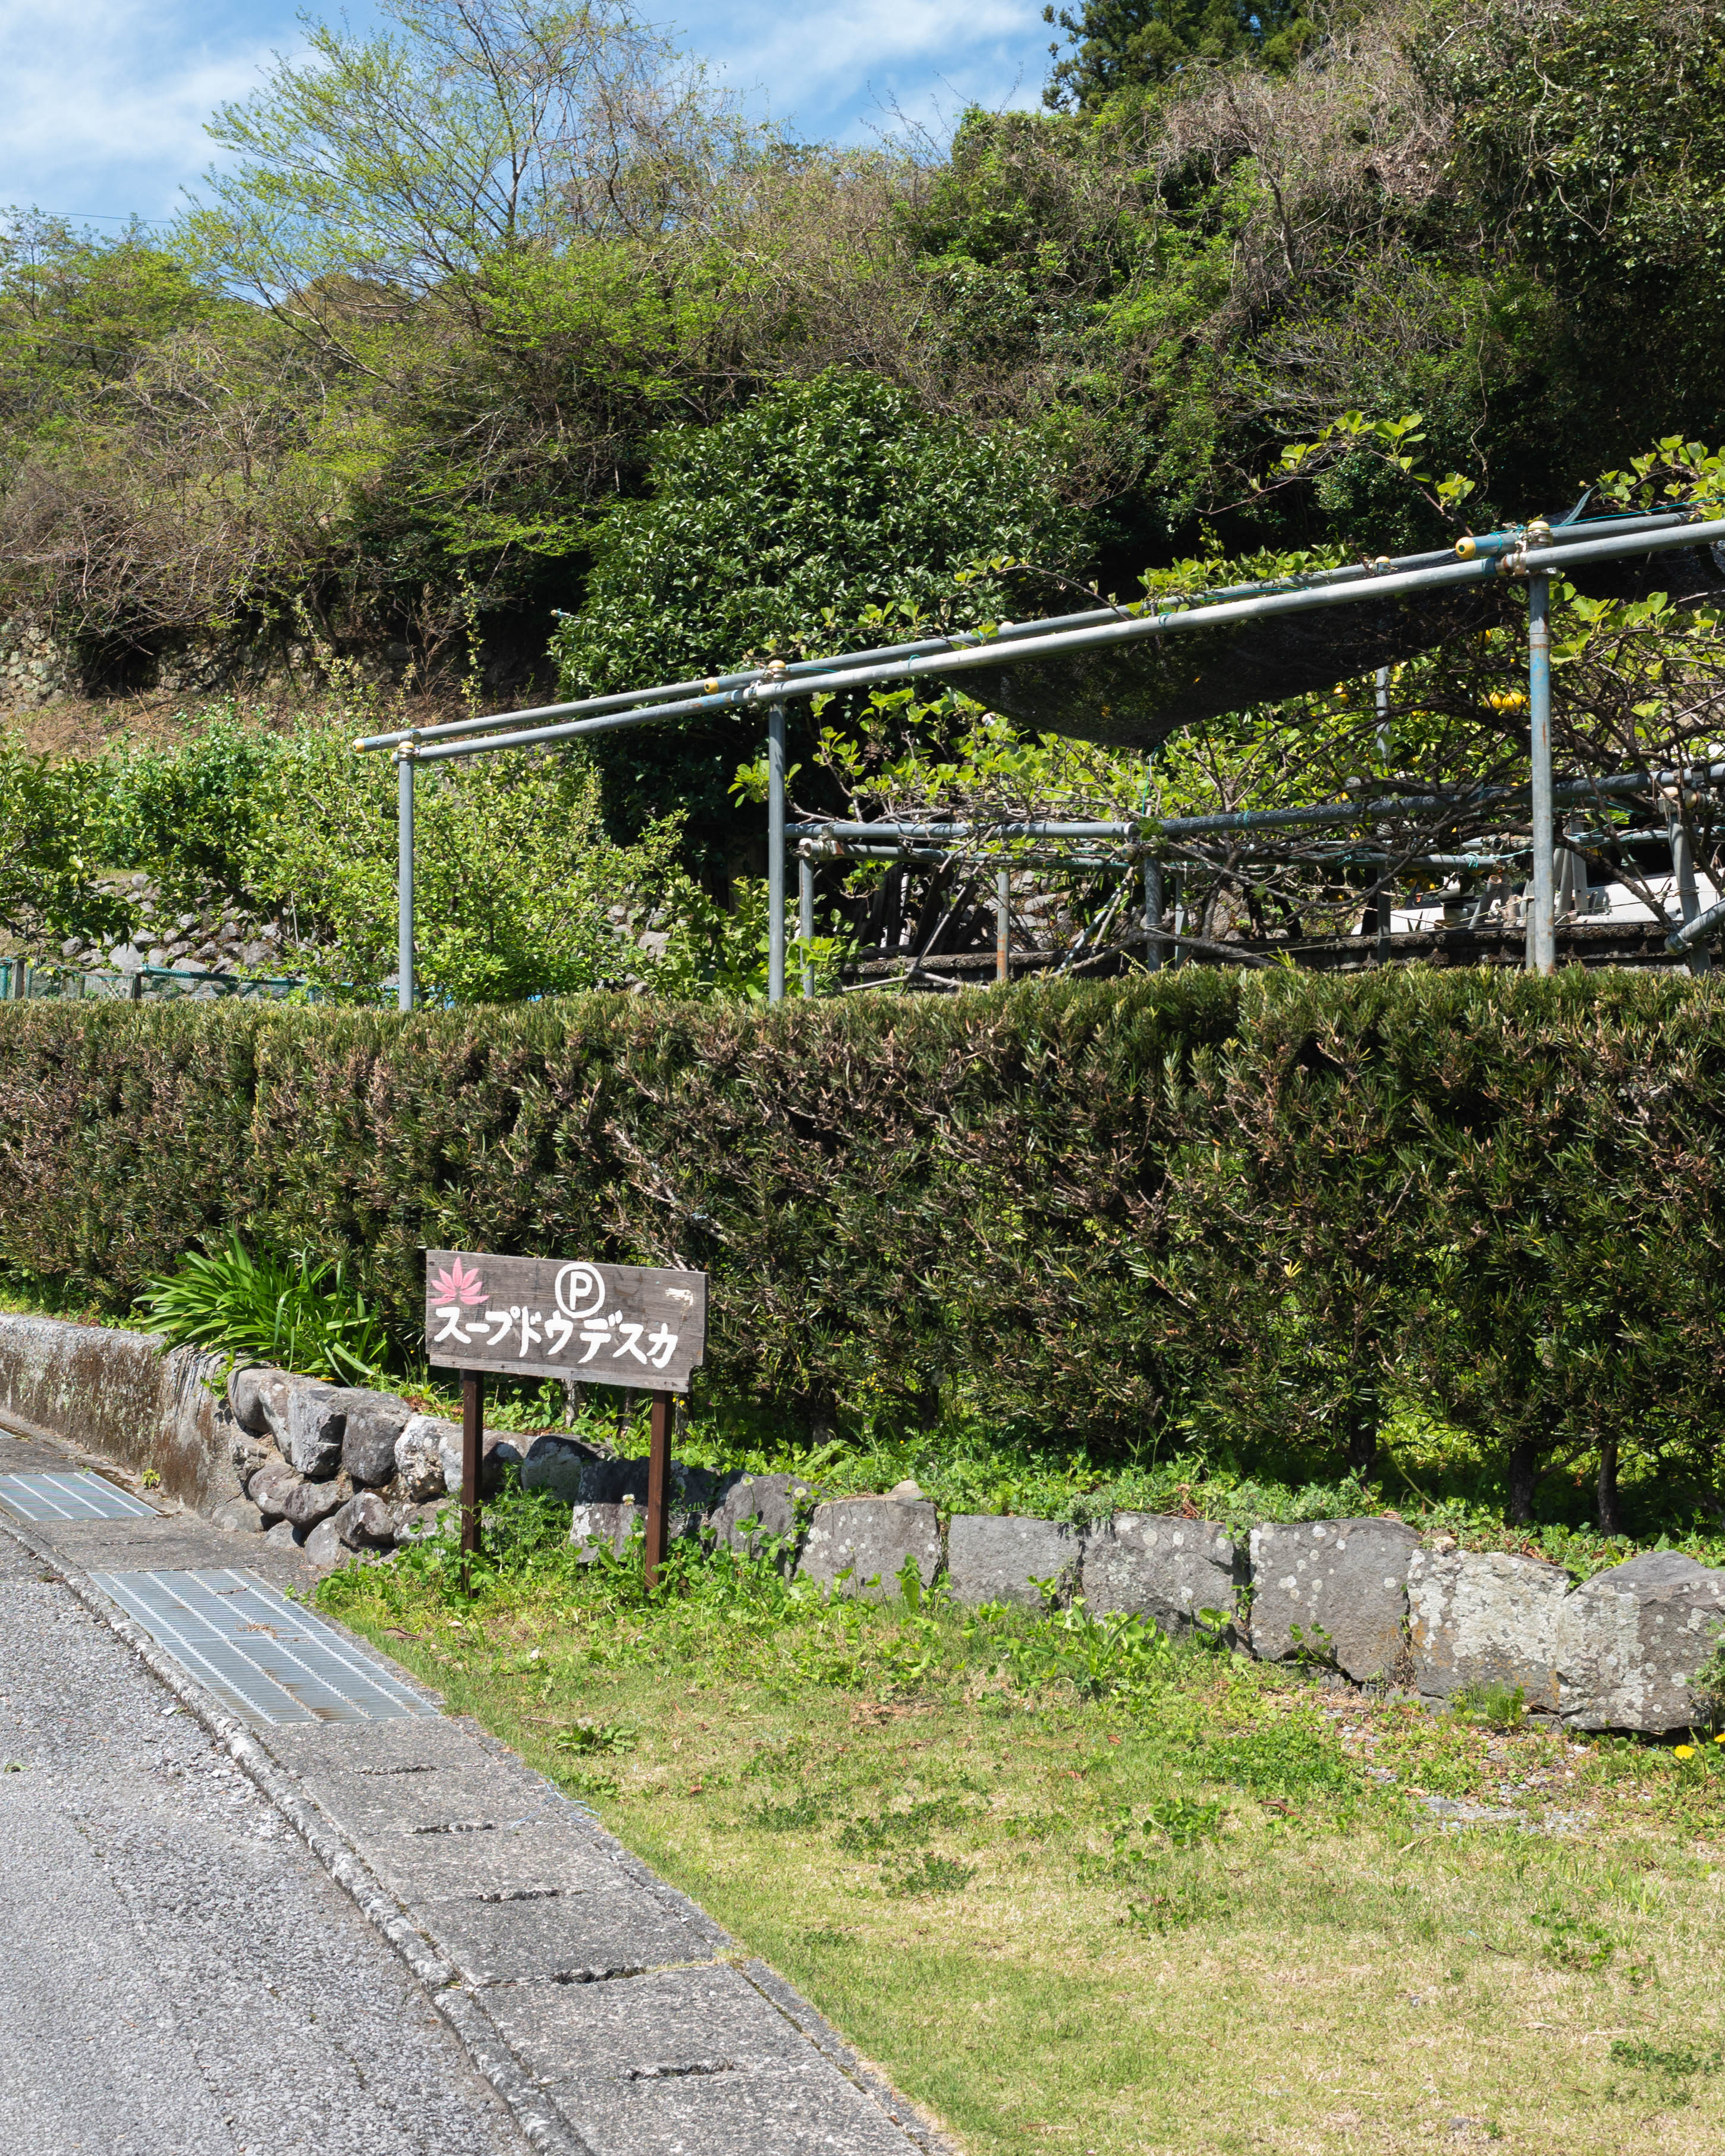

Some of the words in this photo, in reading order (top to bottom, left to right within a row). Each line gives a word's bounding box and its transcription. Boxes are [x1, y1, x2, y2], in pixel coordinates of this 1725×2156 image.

[433, 1306, 678, 1369] スープドウデスカ
